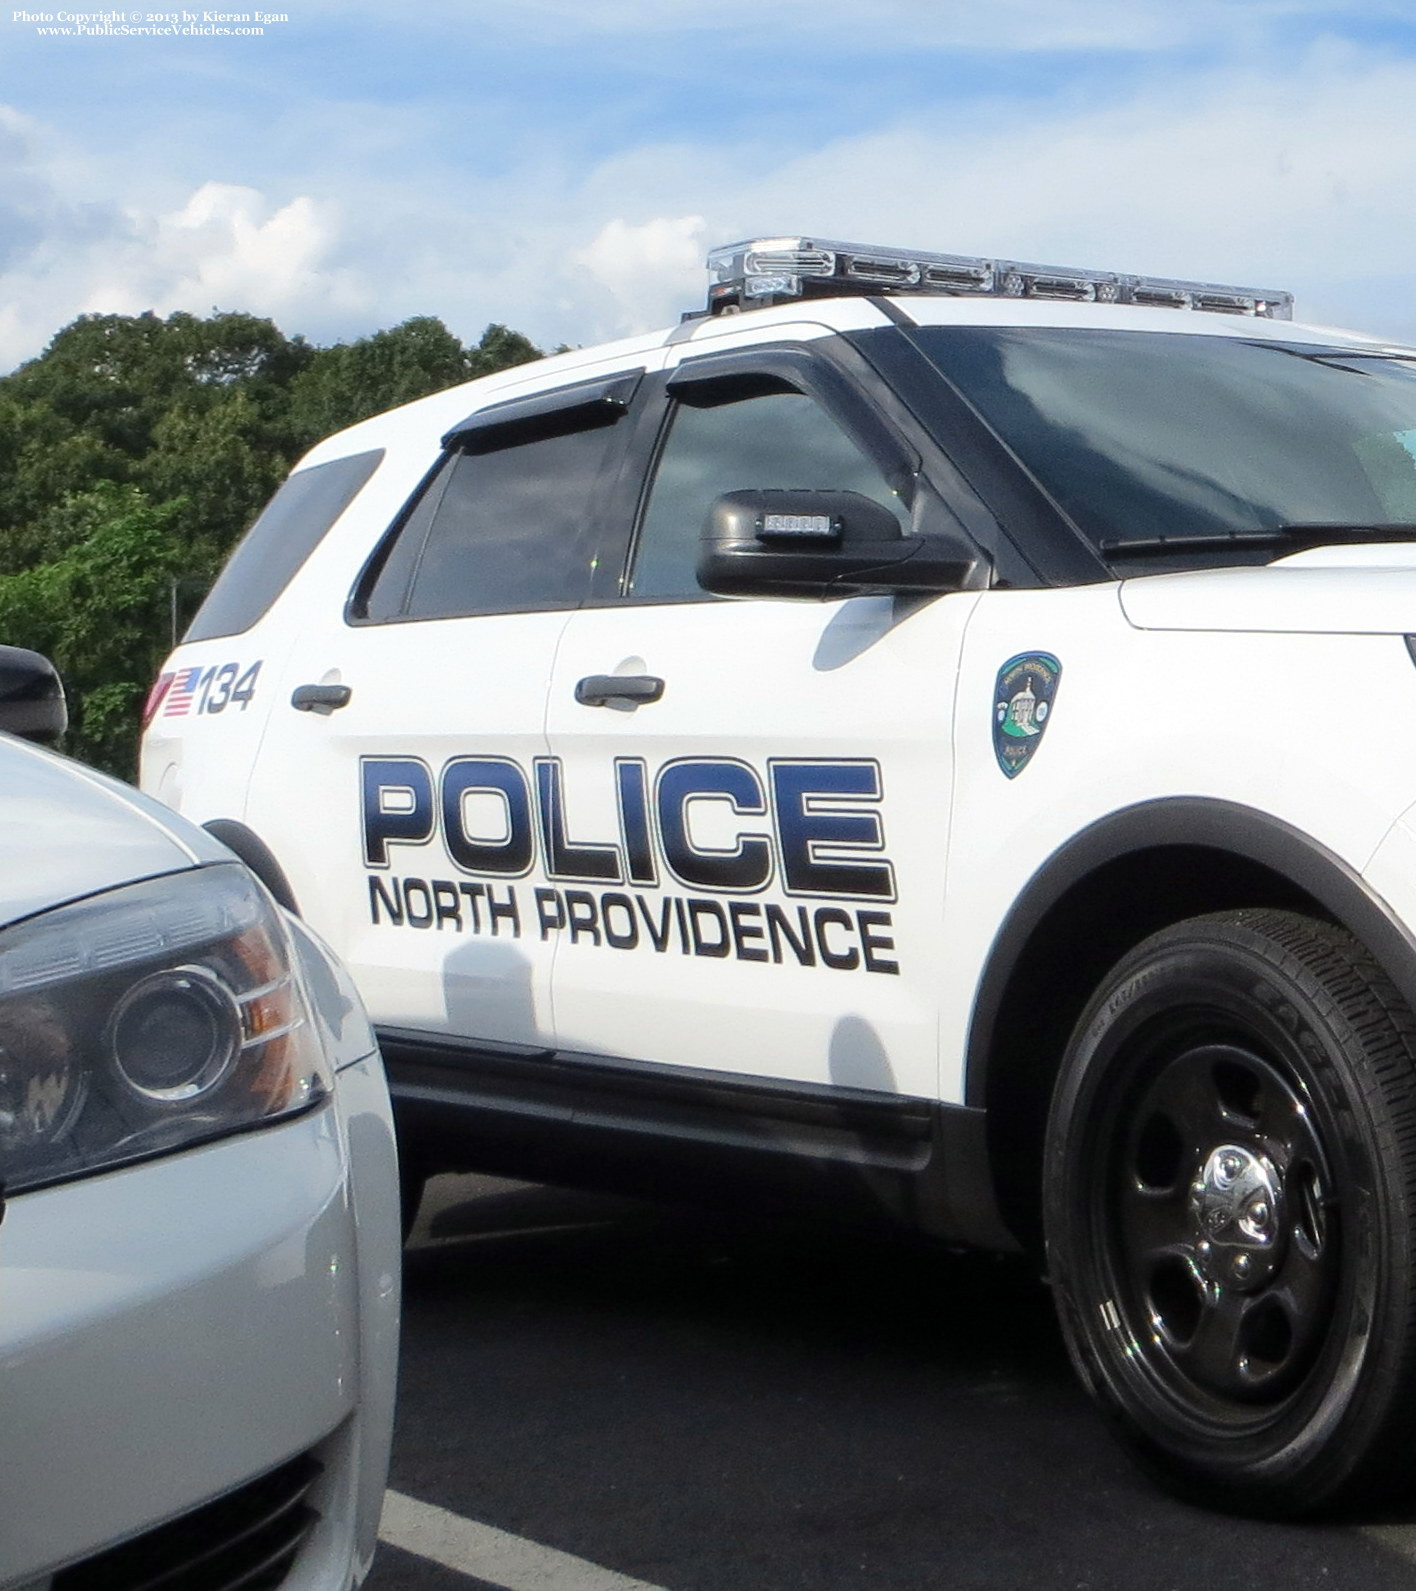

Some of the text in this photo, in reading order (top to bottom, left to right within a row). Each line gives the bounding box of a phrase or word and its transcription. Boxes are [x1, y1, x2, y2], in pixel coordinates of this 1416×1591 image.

[197, 659, 264, 716] 134
[359, 754, 899, 902] POLICE
[368, 875, 901, 976] NORTH PROVIDENCE
